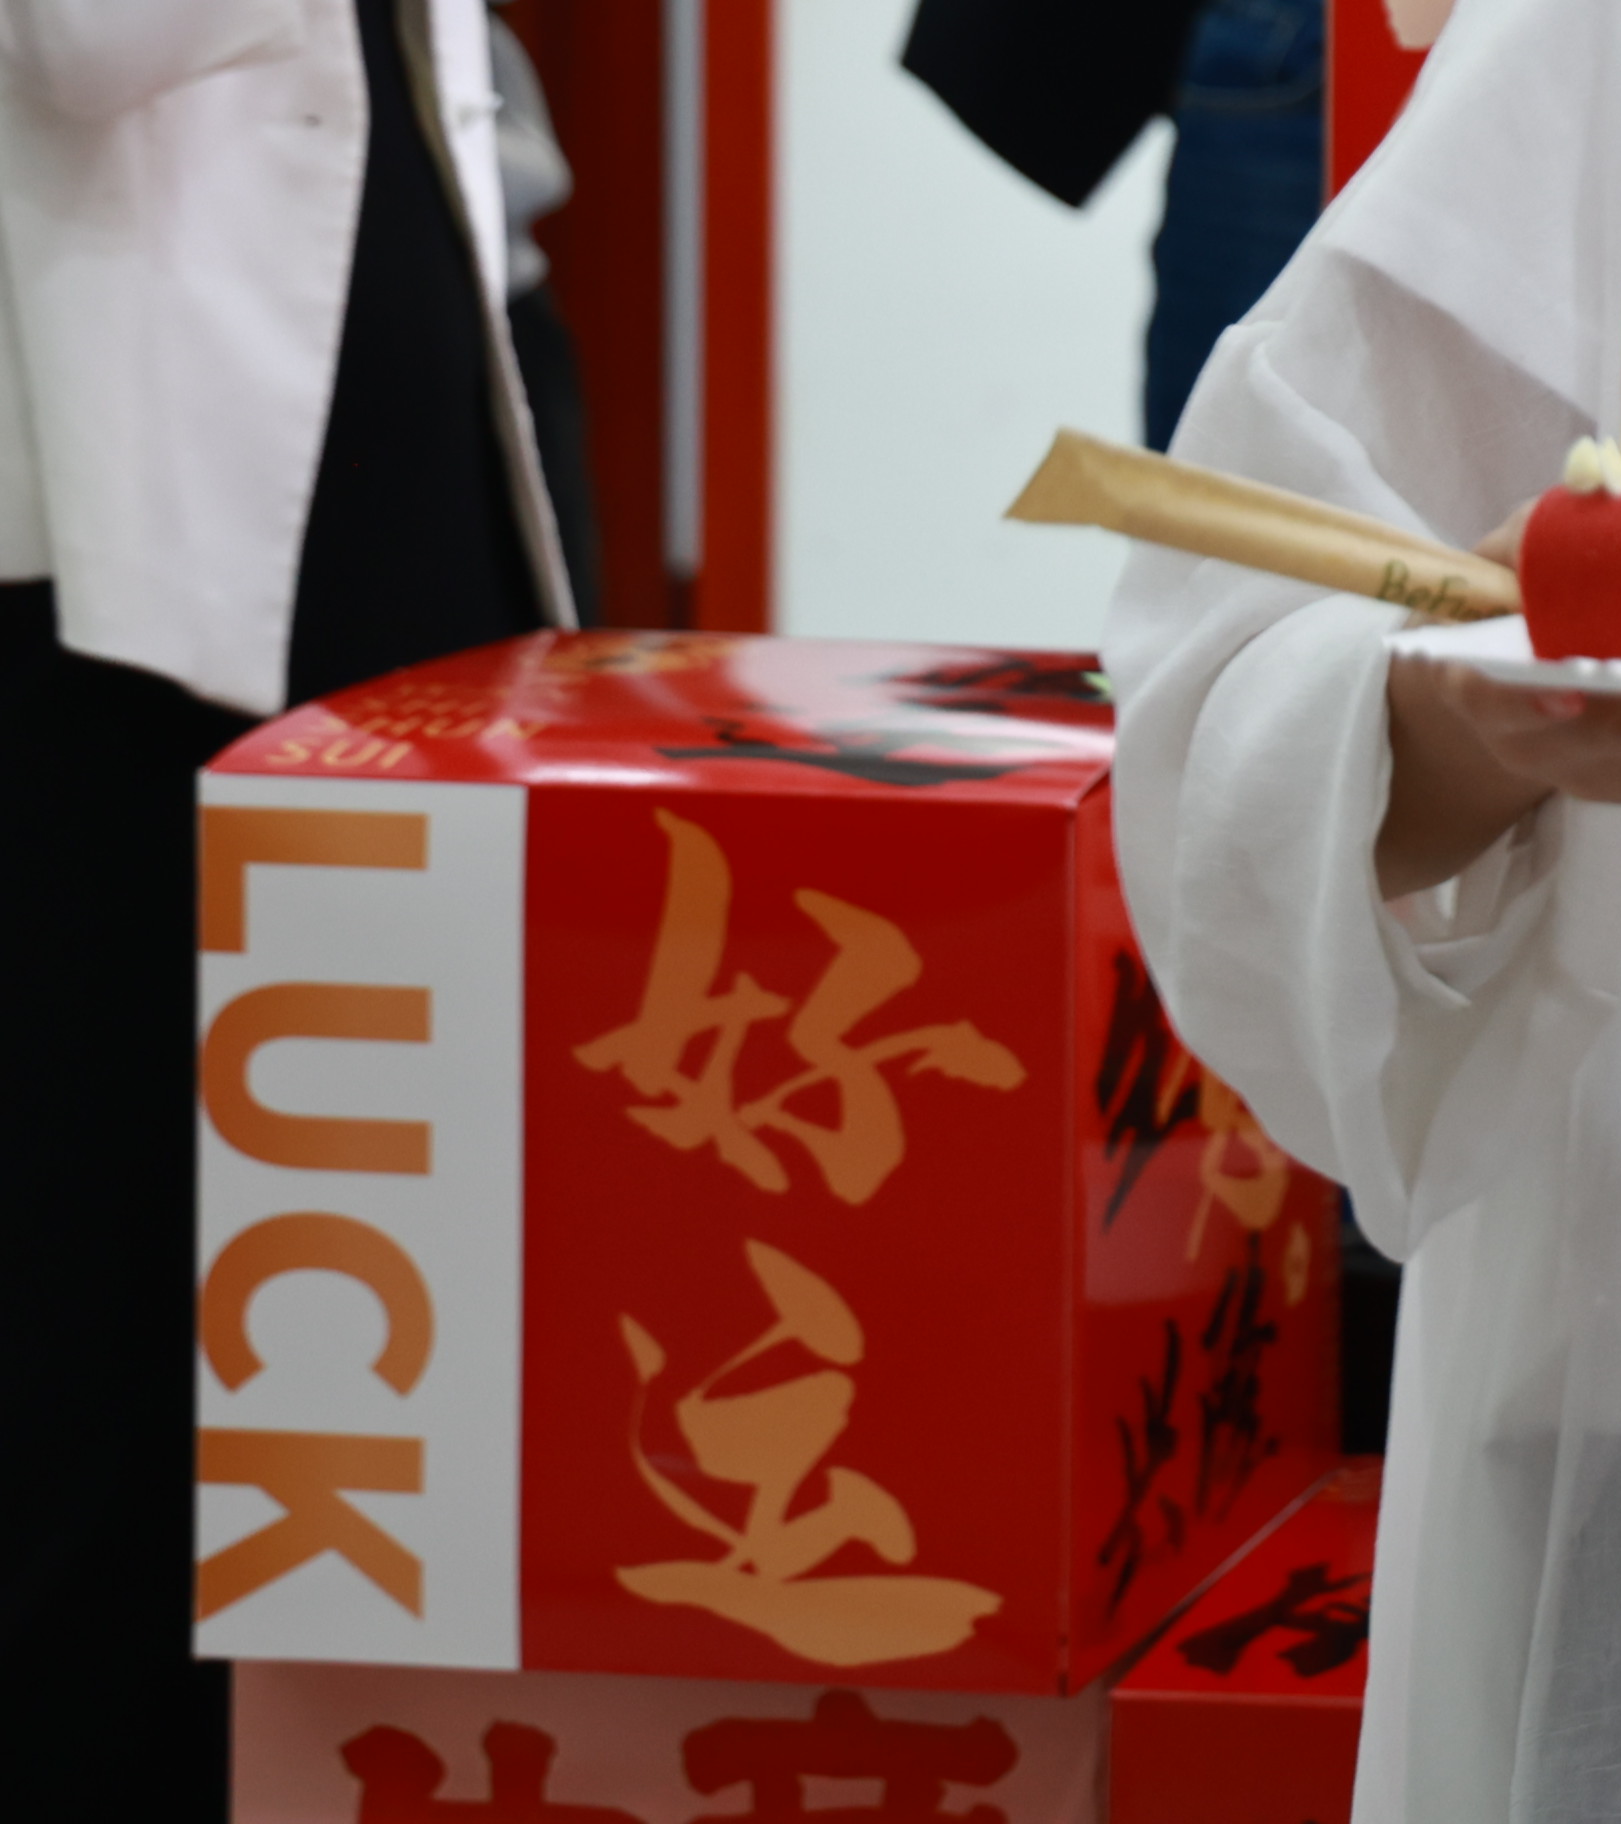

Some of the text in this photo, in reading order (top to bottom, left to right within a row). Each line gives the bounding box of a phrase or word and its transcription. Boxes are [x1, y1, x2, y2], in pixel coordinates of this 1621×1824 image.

[263, 737, 415, 771] SUI
[192, 806, 436, 1626] LUCK
[572, 806, 1027, 1668] 好运
